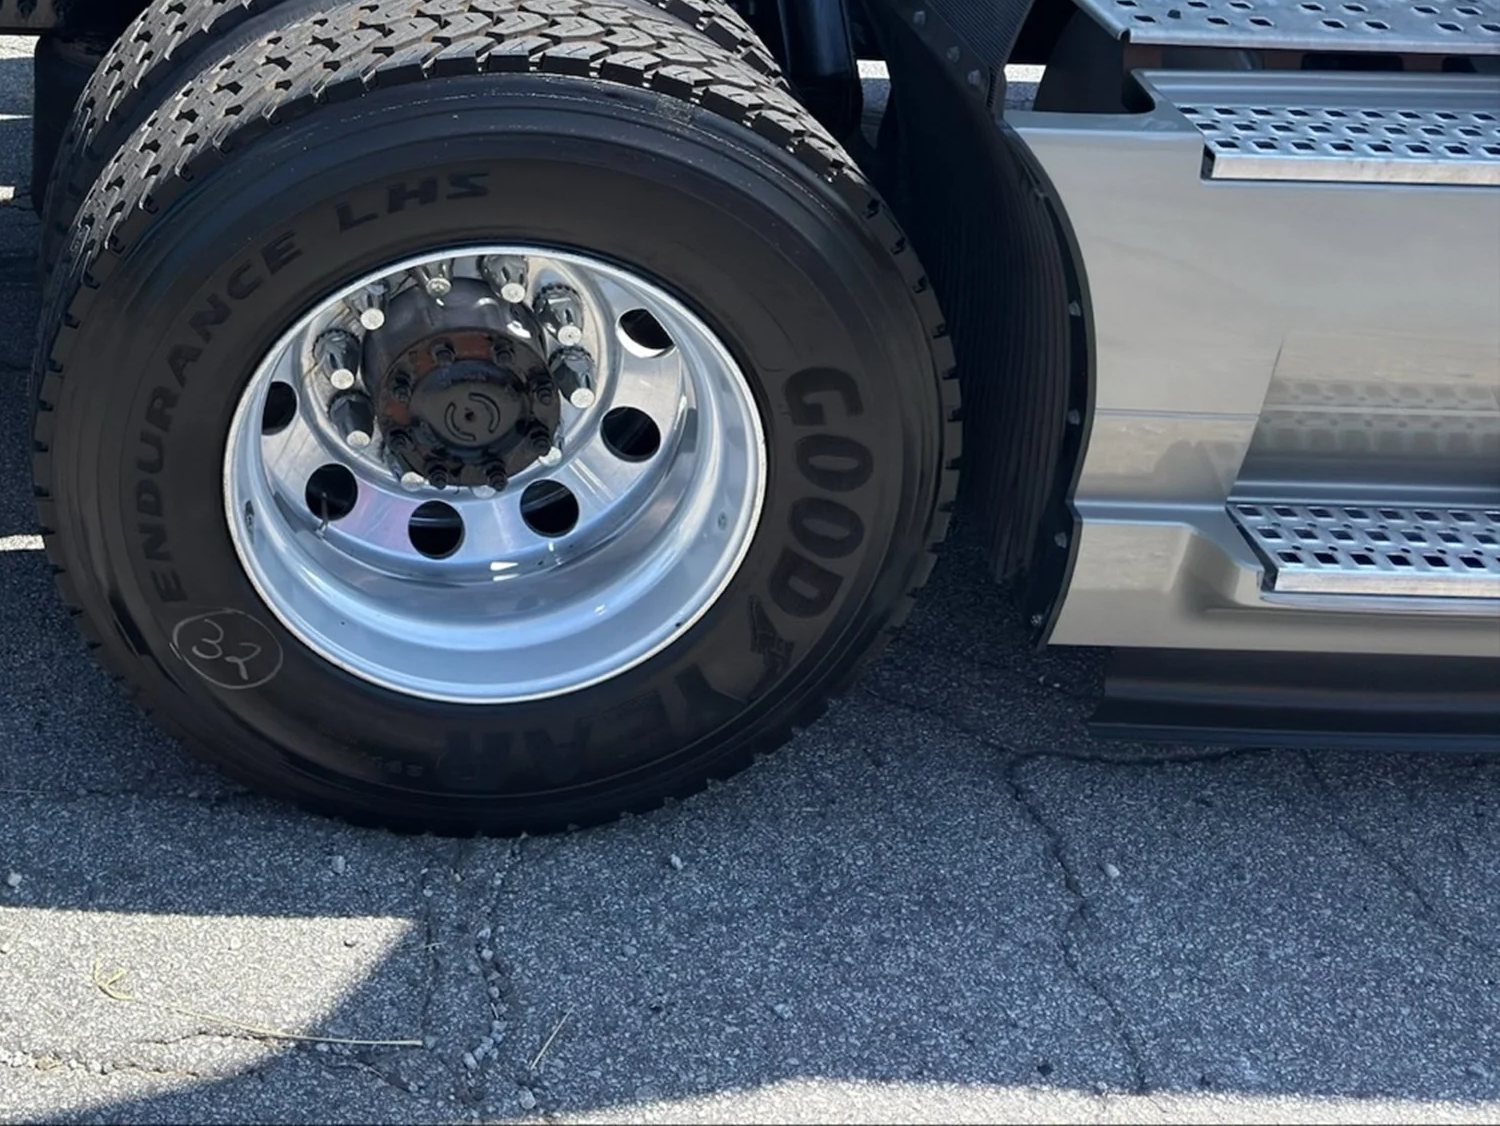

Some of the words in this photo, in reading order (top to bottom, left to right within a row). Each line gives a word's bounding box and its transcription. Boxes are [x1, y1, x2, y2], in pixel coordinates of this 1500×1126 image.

[337, 168, 491, 234] LHS
[132, 222, 304, 604] ENDURANCE
[440, 364, 876, 788] GOODYEAR
